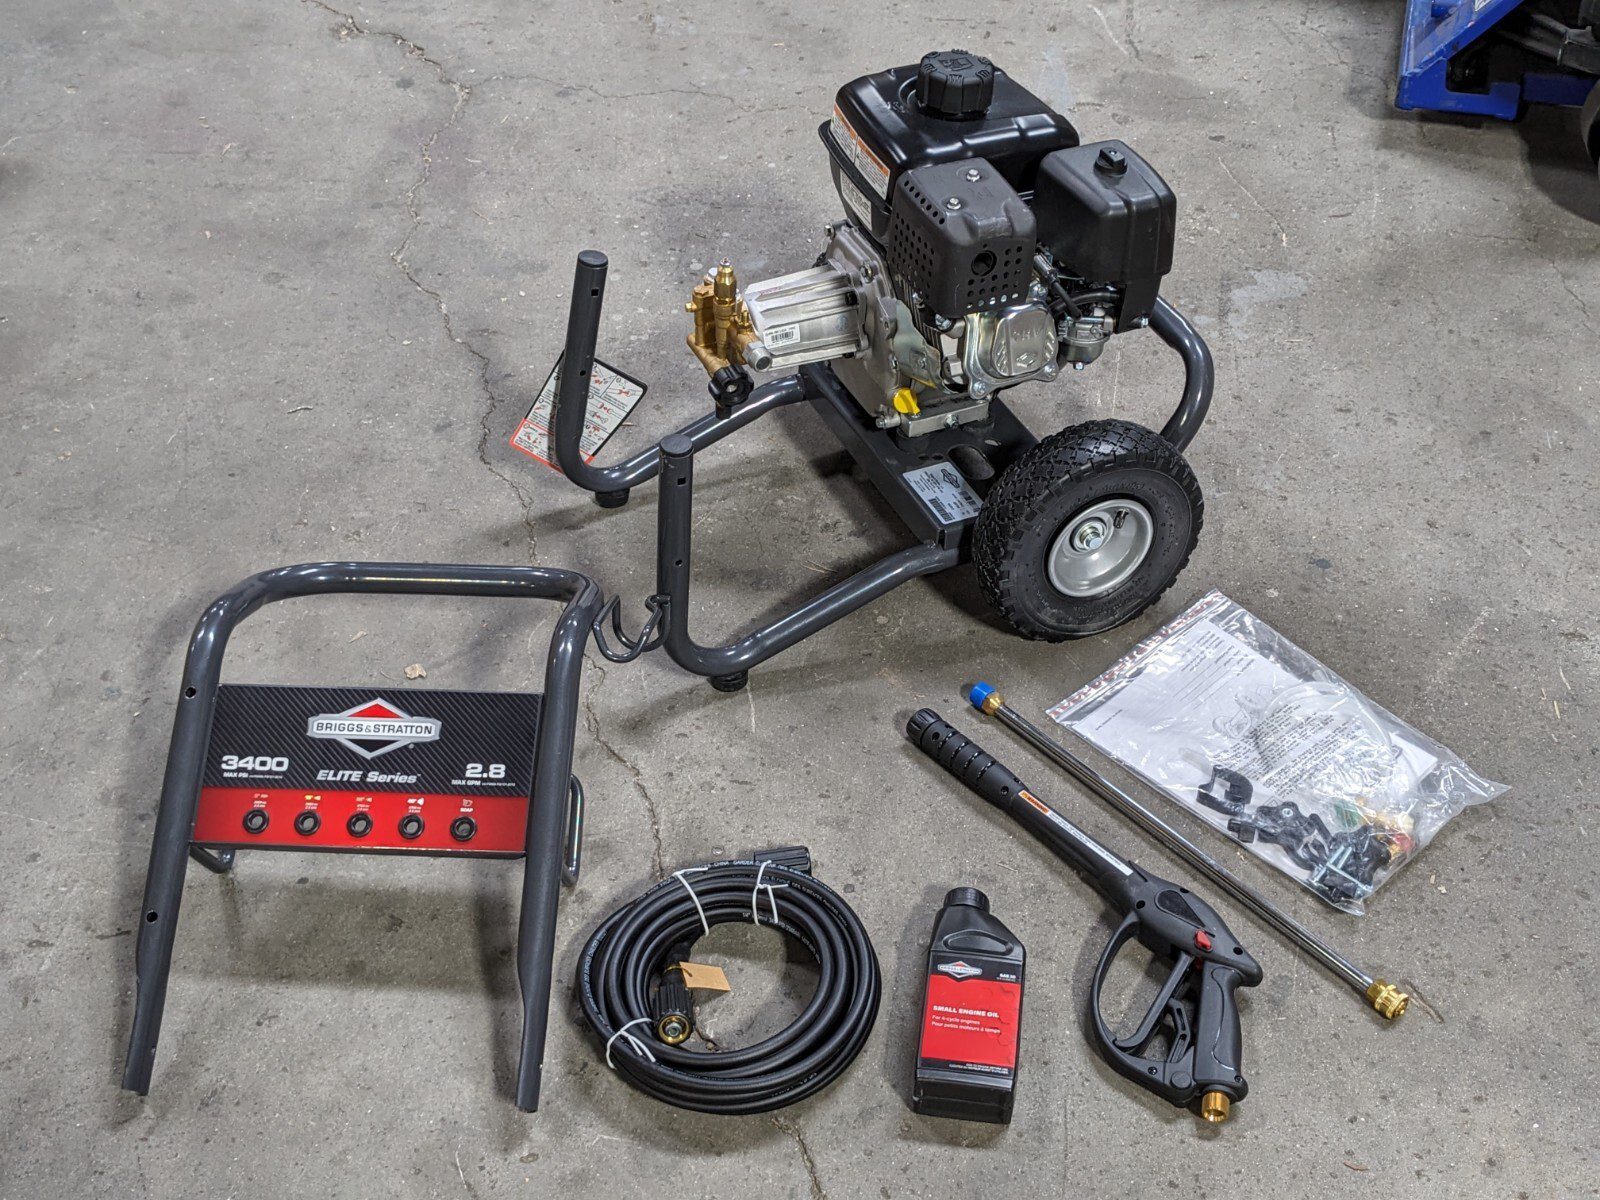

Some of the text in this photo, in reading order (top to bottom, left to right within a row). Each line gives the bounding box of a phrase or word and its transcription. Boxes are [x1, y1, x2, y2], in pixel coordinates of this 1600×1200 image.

[316, 722, 433, 735] BRIGGS&STRATTON
[221, 754, 289, 772] 3400
[316, 770, 363, 781] ELITE
[465, 763, 506, 778] 2.8
[933, 1005, 957, 1013] SMALL
[958, 1008, 986, 1017] ENGINE
